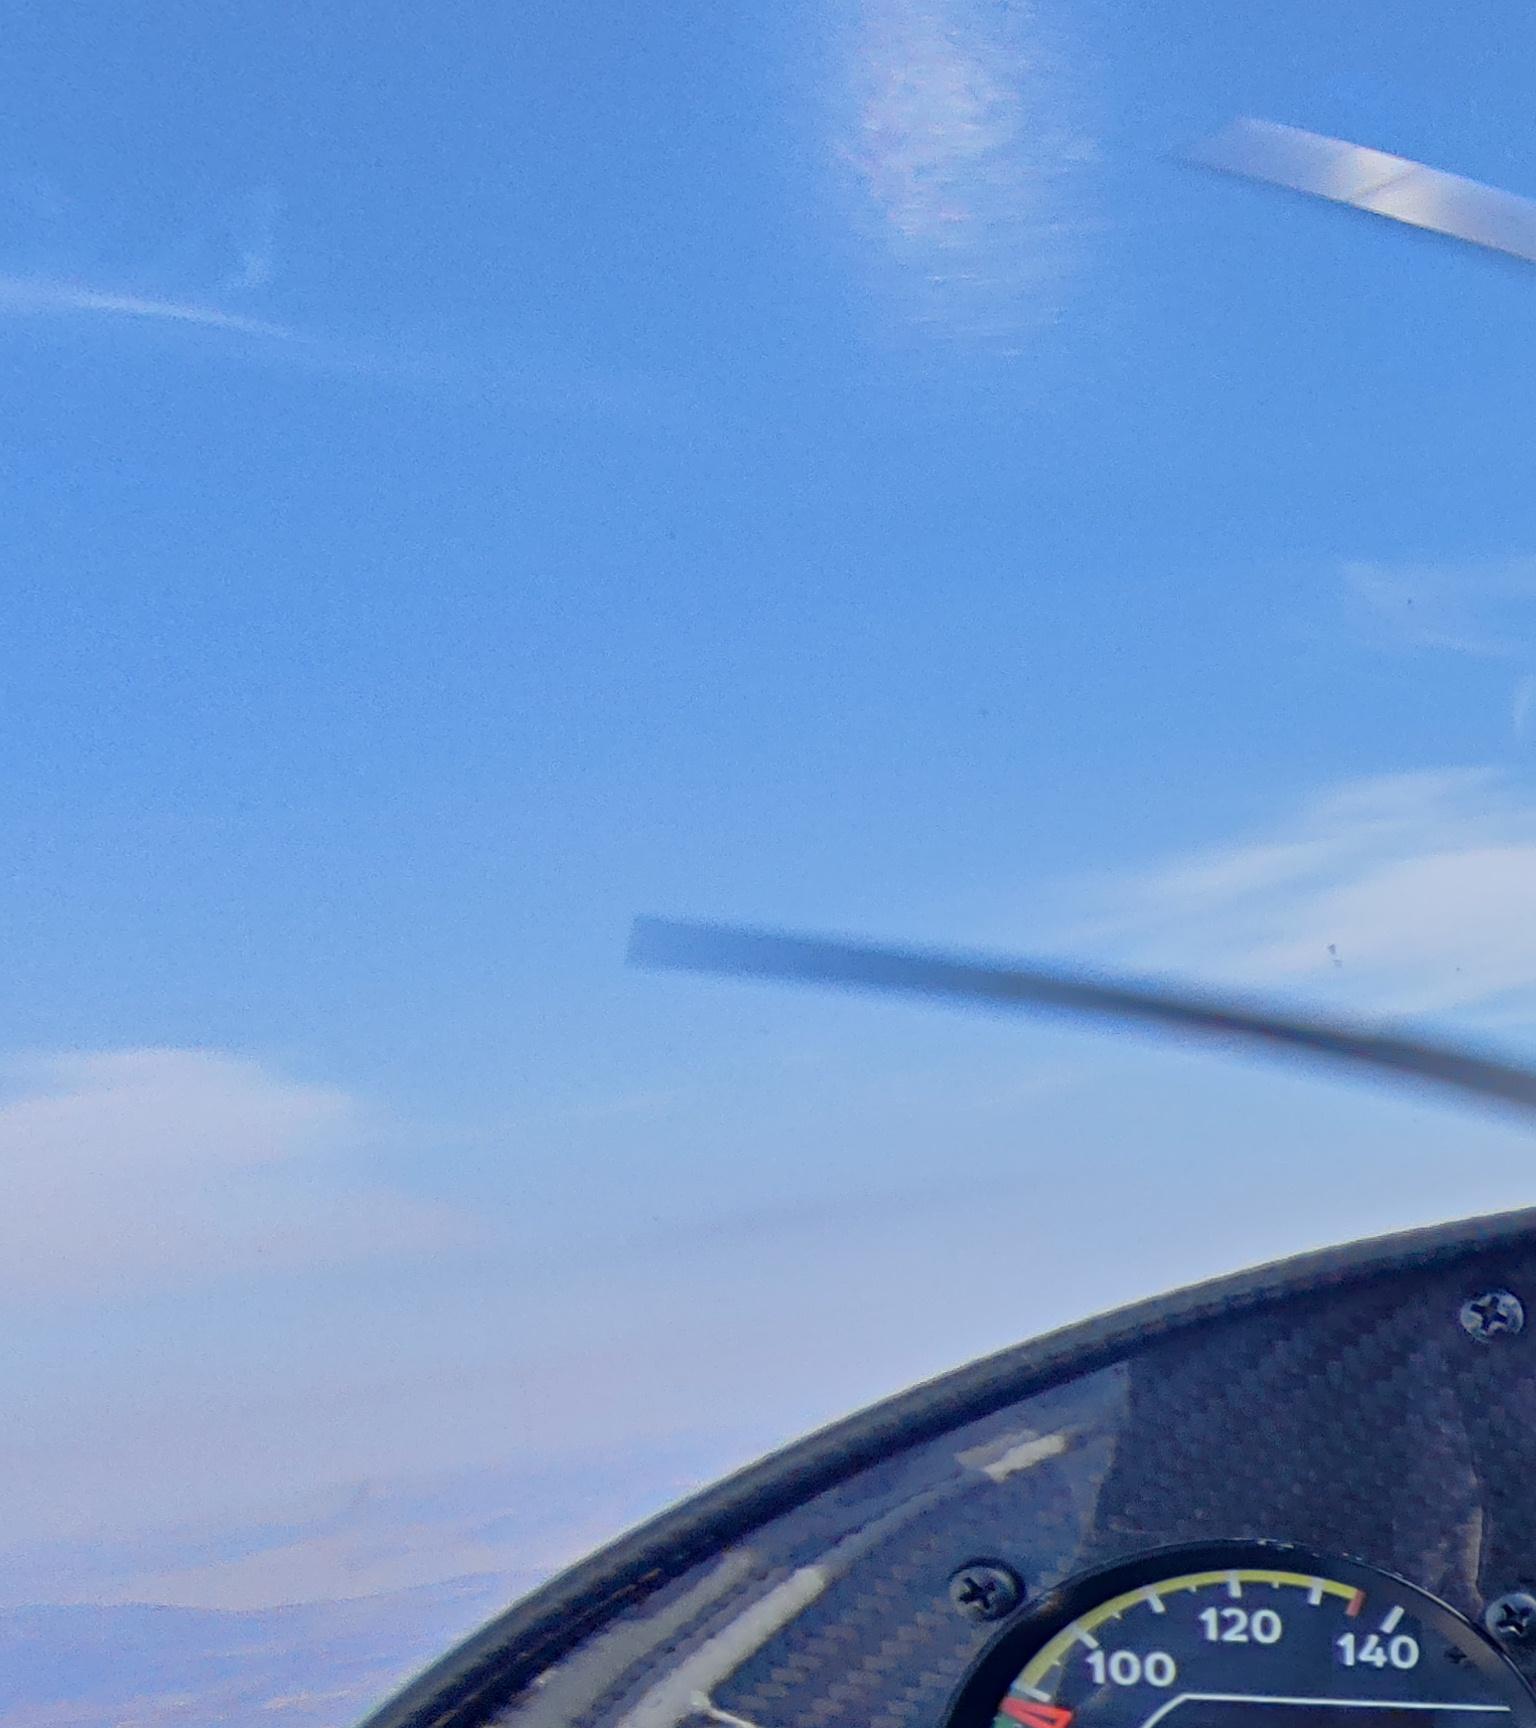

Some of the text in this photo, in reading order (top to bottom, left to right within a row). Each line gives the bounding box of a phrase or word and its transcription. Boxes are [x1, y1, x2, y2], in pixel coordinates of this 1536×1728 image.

[1199, 1608, 1282, 1644] 120
[1088, 1651, 1176, 1687] 100
[1337, 1633, 1419, 1669] 140
